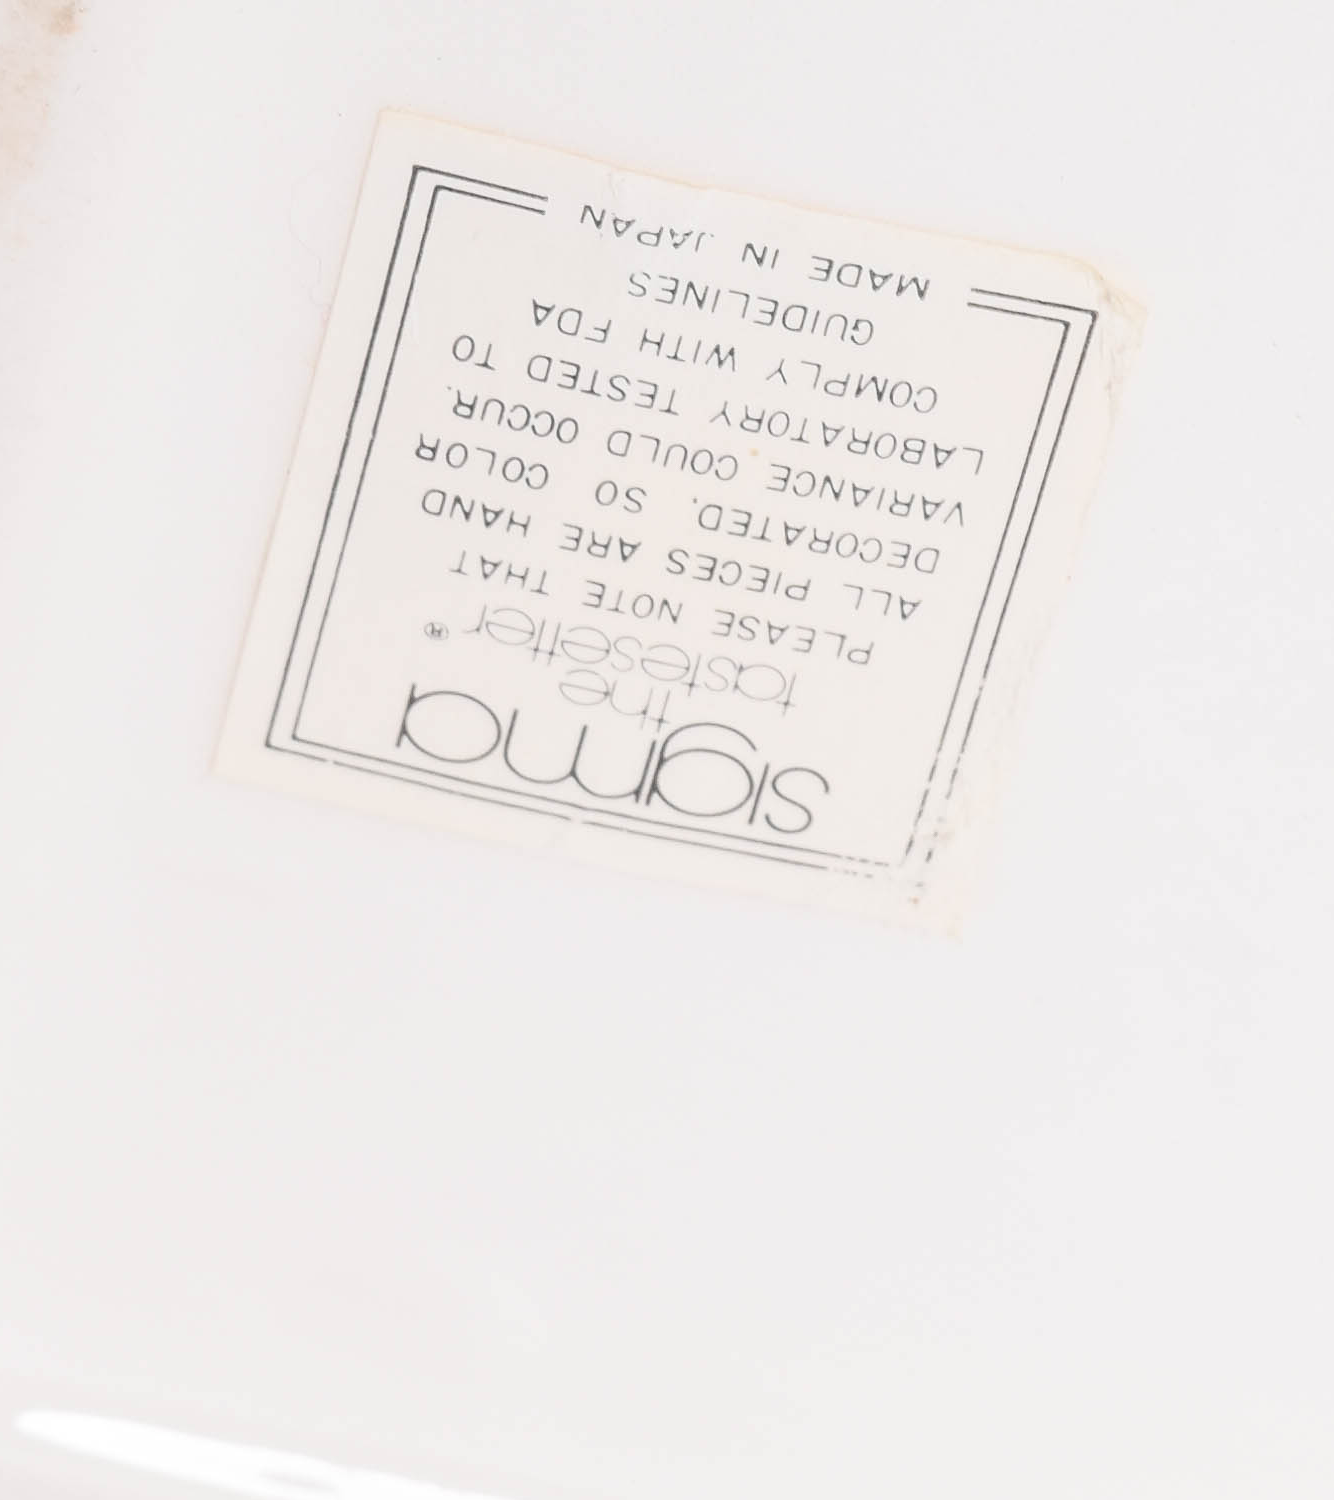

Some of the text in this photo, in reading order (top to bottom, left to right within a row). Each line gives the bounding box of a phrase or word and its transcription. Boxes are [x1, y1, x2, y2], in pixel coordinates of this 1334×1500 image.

[579, 204, 931, 302] MADE IN JAPAN
[627, 271, 875, 347] GUIDELINES
[451, 333, 985, 476] LABORATORY TESTED TO
[531, 297, 939, 414] COMPLY WITH FDA
[413, 432, 550, 491] COLOR
[446, 385, 964, 528] VARIANCE COULD OCCUR.
[594, 479, 648, 515] SO
[420, 488, 923, 622] ALL PIECES ARE HAND
[448, 549, 875, 666] PLEASE NOTE THAT
[394, 682, 831, 835] sigma
[557, 668, 671, 734] the
